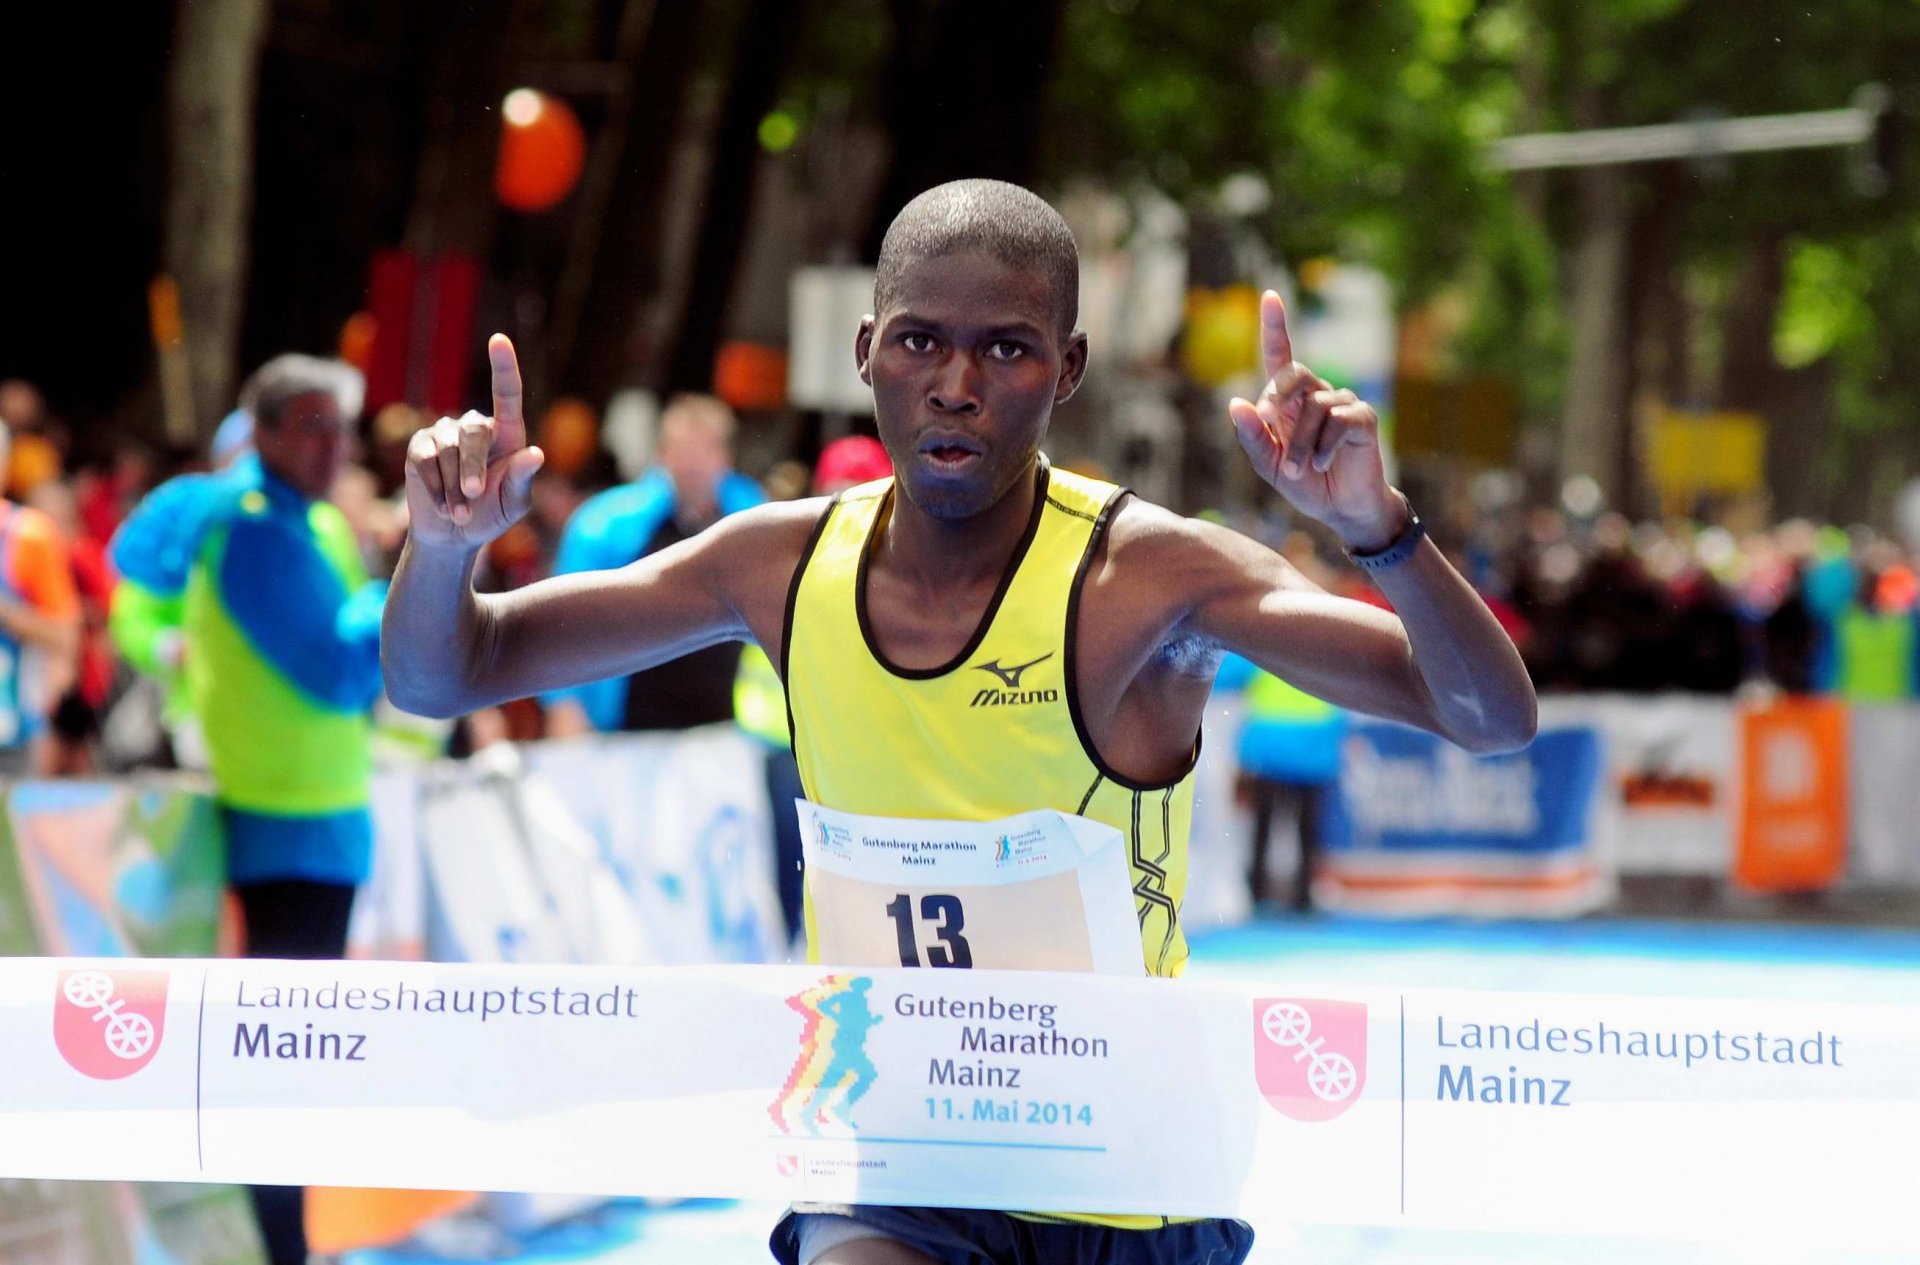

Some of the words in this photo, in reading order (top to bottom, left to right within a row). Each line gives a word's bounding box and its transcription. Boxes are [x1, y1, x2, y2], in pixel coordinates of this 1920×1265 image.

[862, 836, 918, 853] Gutenberg
[921, 840, 977, 851] Marathon
[902, 855, 936, 865] Mainz
[886, 893, 973, 969] 13
[236, 980, 639, 1022] Landeshauptstadt
[894, 993, 1057, 1029] Gutenberg
[233, 1022, 367, 1061] Mainz
[960, 1026, 1109, 1058] Marathon
[1437, 1015, 1844, 1068] Landeshauptstadt
[928, 1058, 1021, 1089] Mainz
[1437, 1064, 1572, 1106] Mainz
[925, 1097, 965, 1121] 11.
[972, 1098, 1019, 1123] Mai
[1025, 1101, 1093, 1126] 2014
